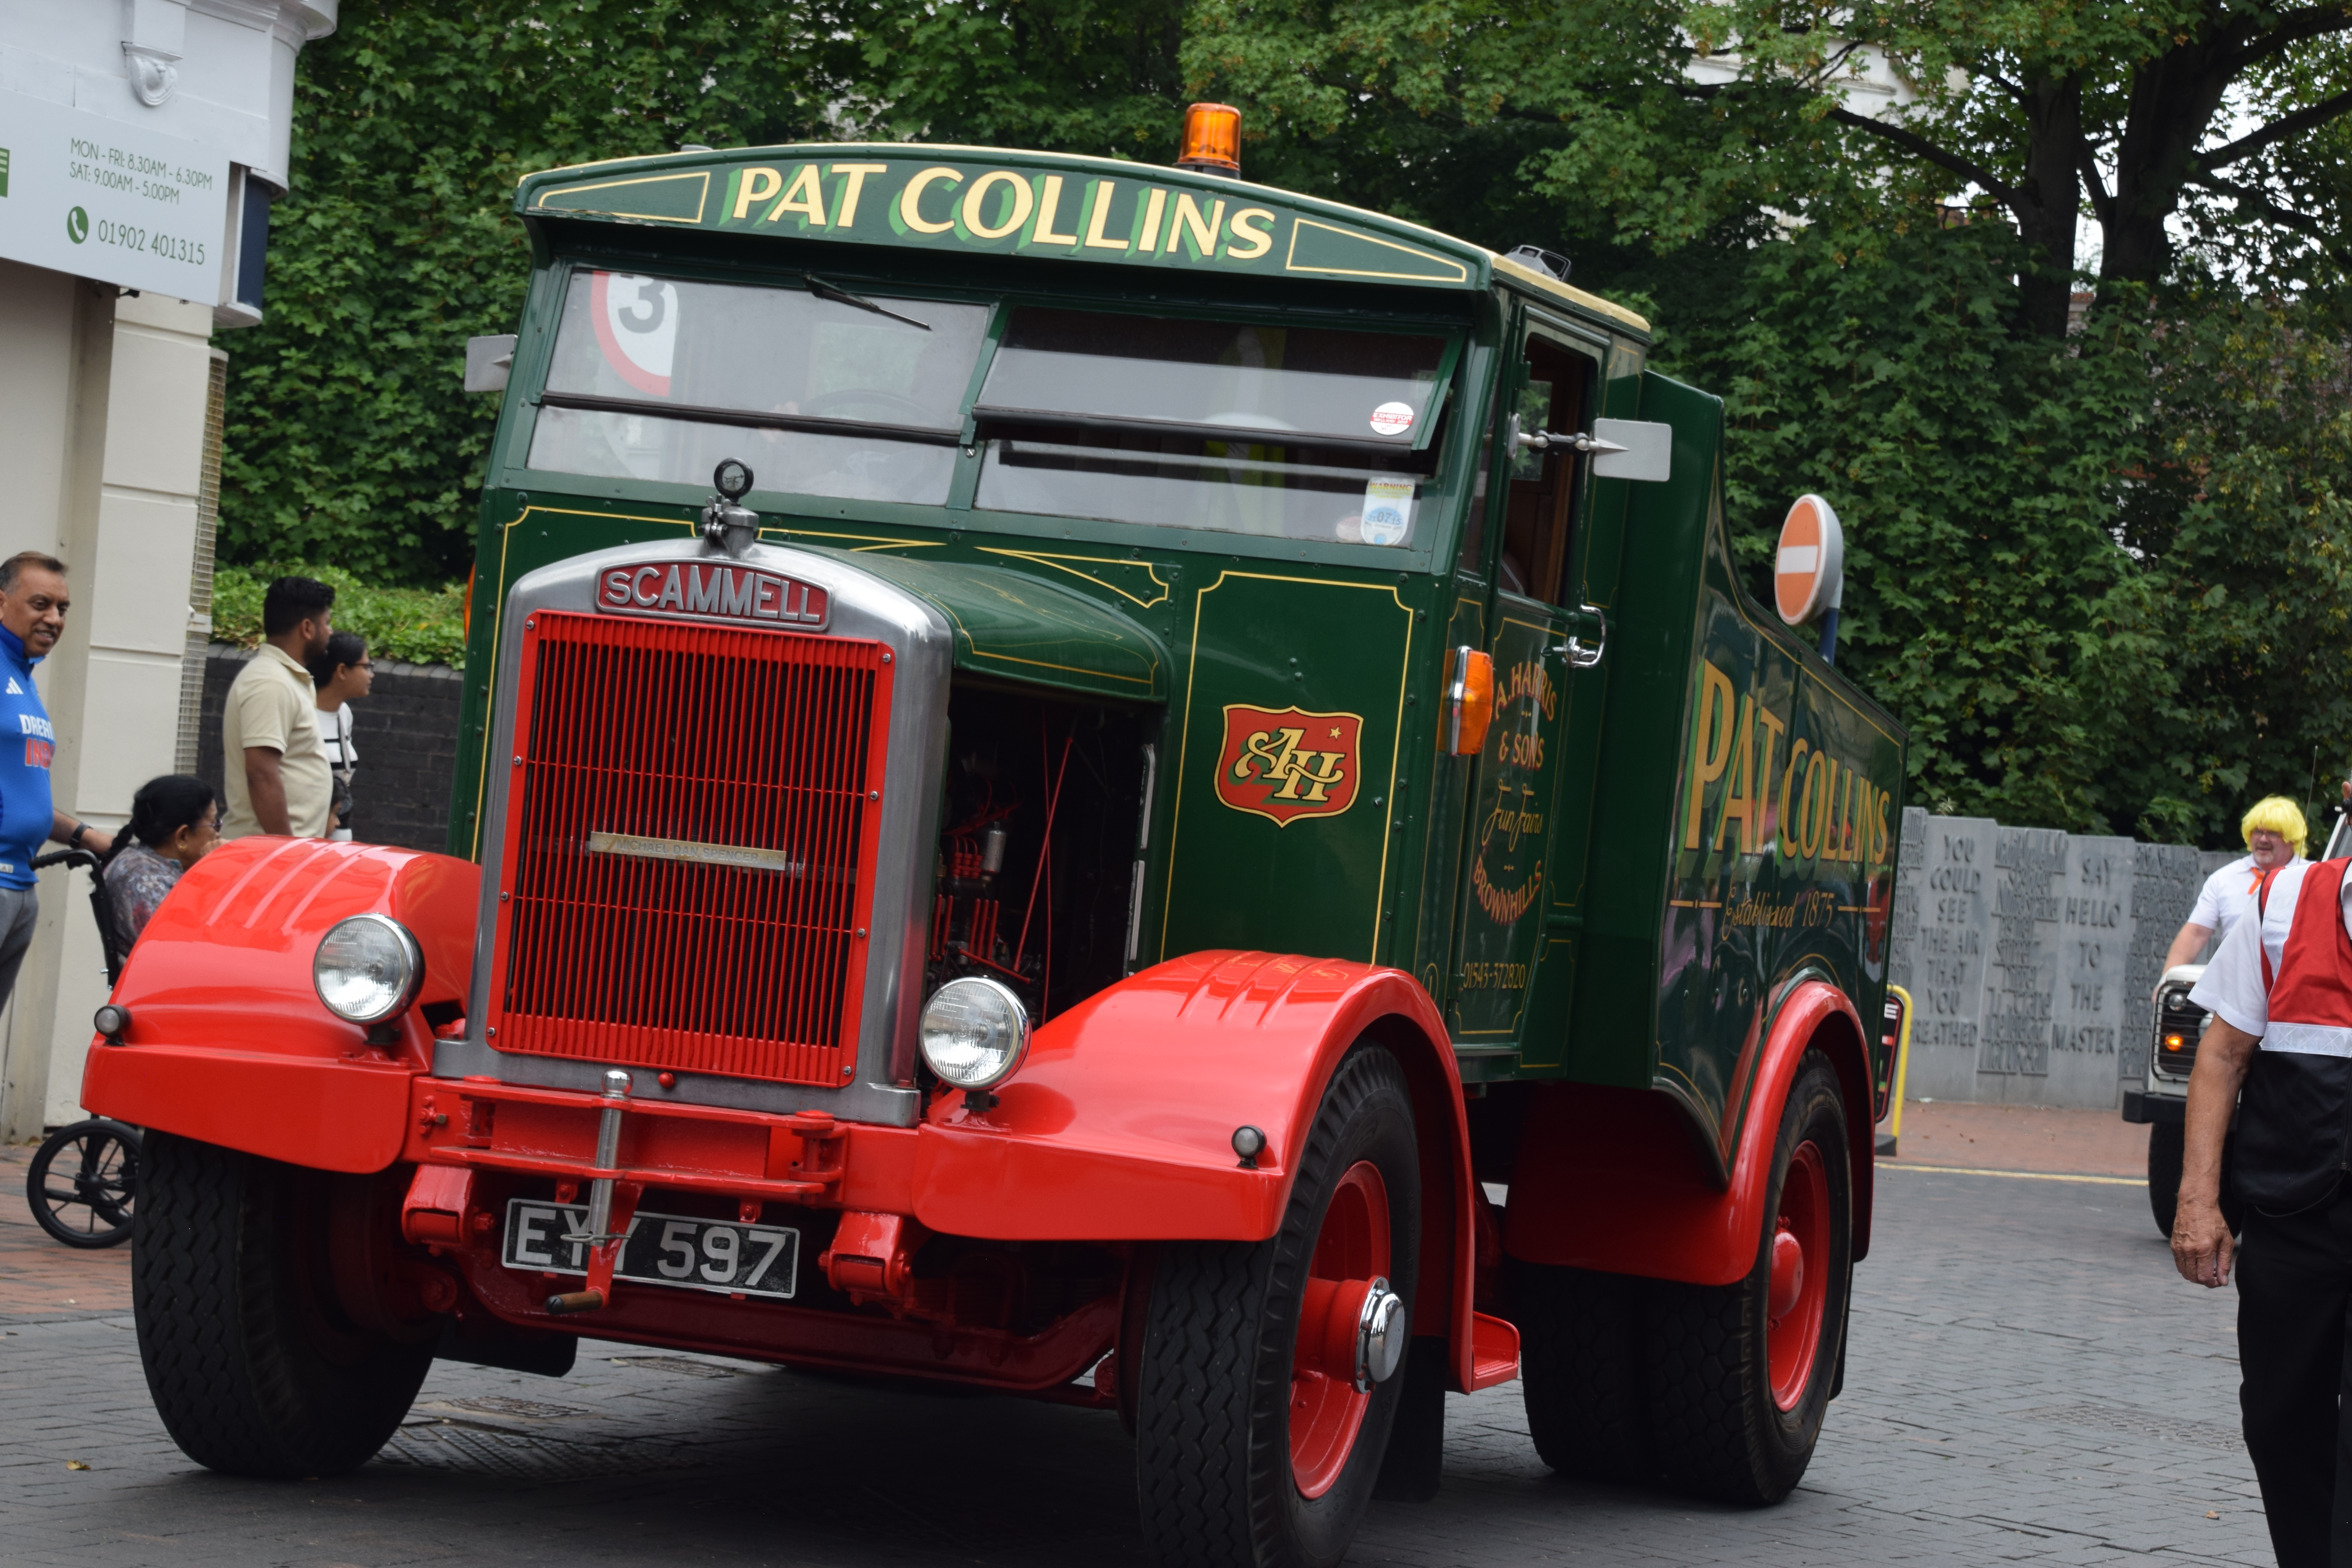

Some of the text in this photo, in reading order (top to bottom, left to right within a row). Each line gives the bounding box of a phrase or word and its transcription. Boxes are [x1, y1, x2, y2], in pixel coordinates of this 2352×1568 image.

[71, 138, 98, 161] MON
[109, 149, 125, 168] FRI:
[129, 154, 167, 179] 8.30AM
[176, 167, 212, 191] 6.30PM
[69, 162, 91, 181] SAT:
[94, 170, 132, 193] 9.00AM
[143, 181, 180, 205] 5.00PM
[731, 163, 1277, 260] PAT COLLINS
[98, 220, 205, 265] 01902 401315
[1373, 412, 1413, 421] EXHIBITOR
[1370, 482, 1412, 491] WARNING
[1377, 511, 1391, 523] 07
[605, 564, 820, 623] SCAMMELL
[1498, 730, 1544, 770] & SONS
[1684, 658, 1890, 864] PAT COLLINS
[1482, 779, 1543, 852] Fun Fairs
[616, 839, 759, 864] MICHAEL DAN SPENCER
[1944, 834, 1975, 863] YOU
[1930, 867, 1981, 894] COULD
[2081, 857, 2111, 886] SAY
[1473, 855, 1541, 925] BROWNHILLS
[1721, 870, 1800, 941] Established
[1802, 890, 1835, 928] 1875
[1937, 898, 1966, 923] SEE
[2065, 897, 2121, 928] HELLO
[1921, 927, 1949, 953] THE
[2079, 942, 2101, 968] TO
[1927, 959, 1966, 985] THAT
[1927, 988, 1960, 1015] YOU
[2071, 984, 2103, 1012] THE
[1911, 1019, 1978, 1047] REATHED
[2052, 1023, 2115, 1054] MASTER
[657, 1221, 787, 1286] 597
